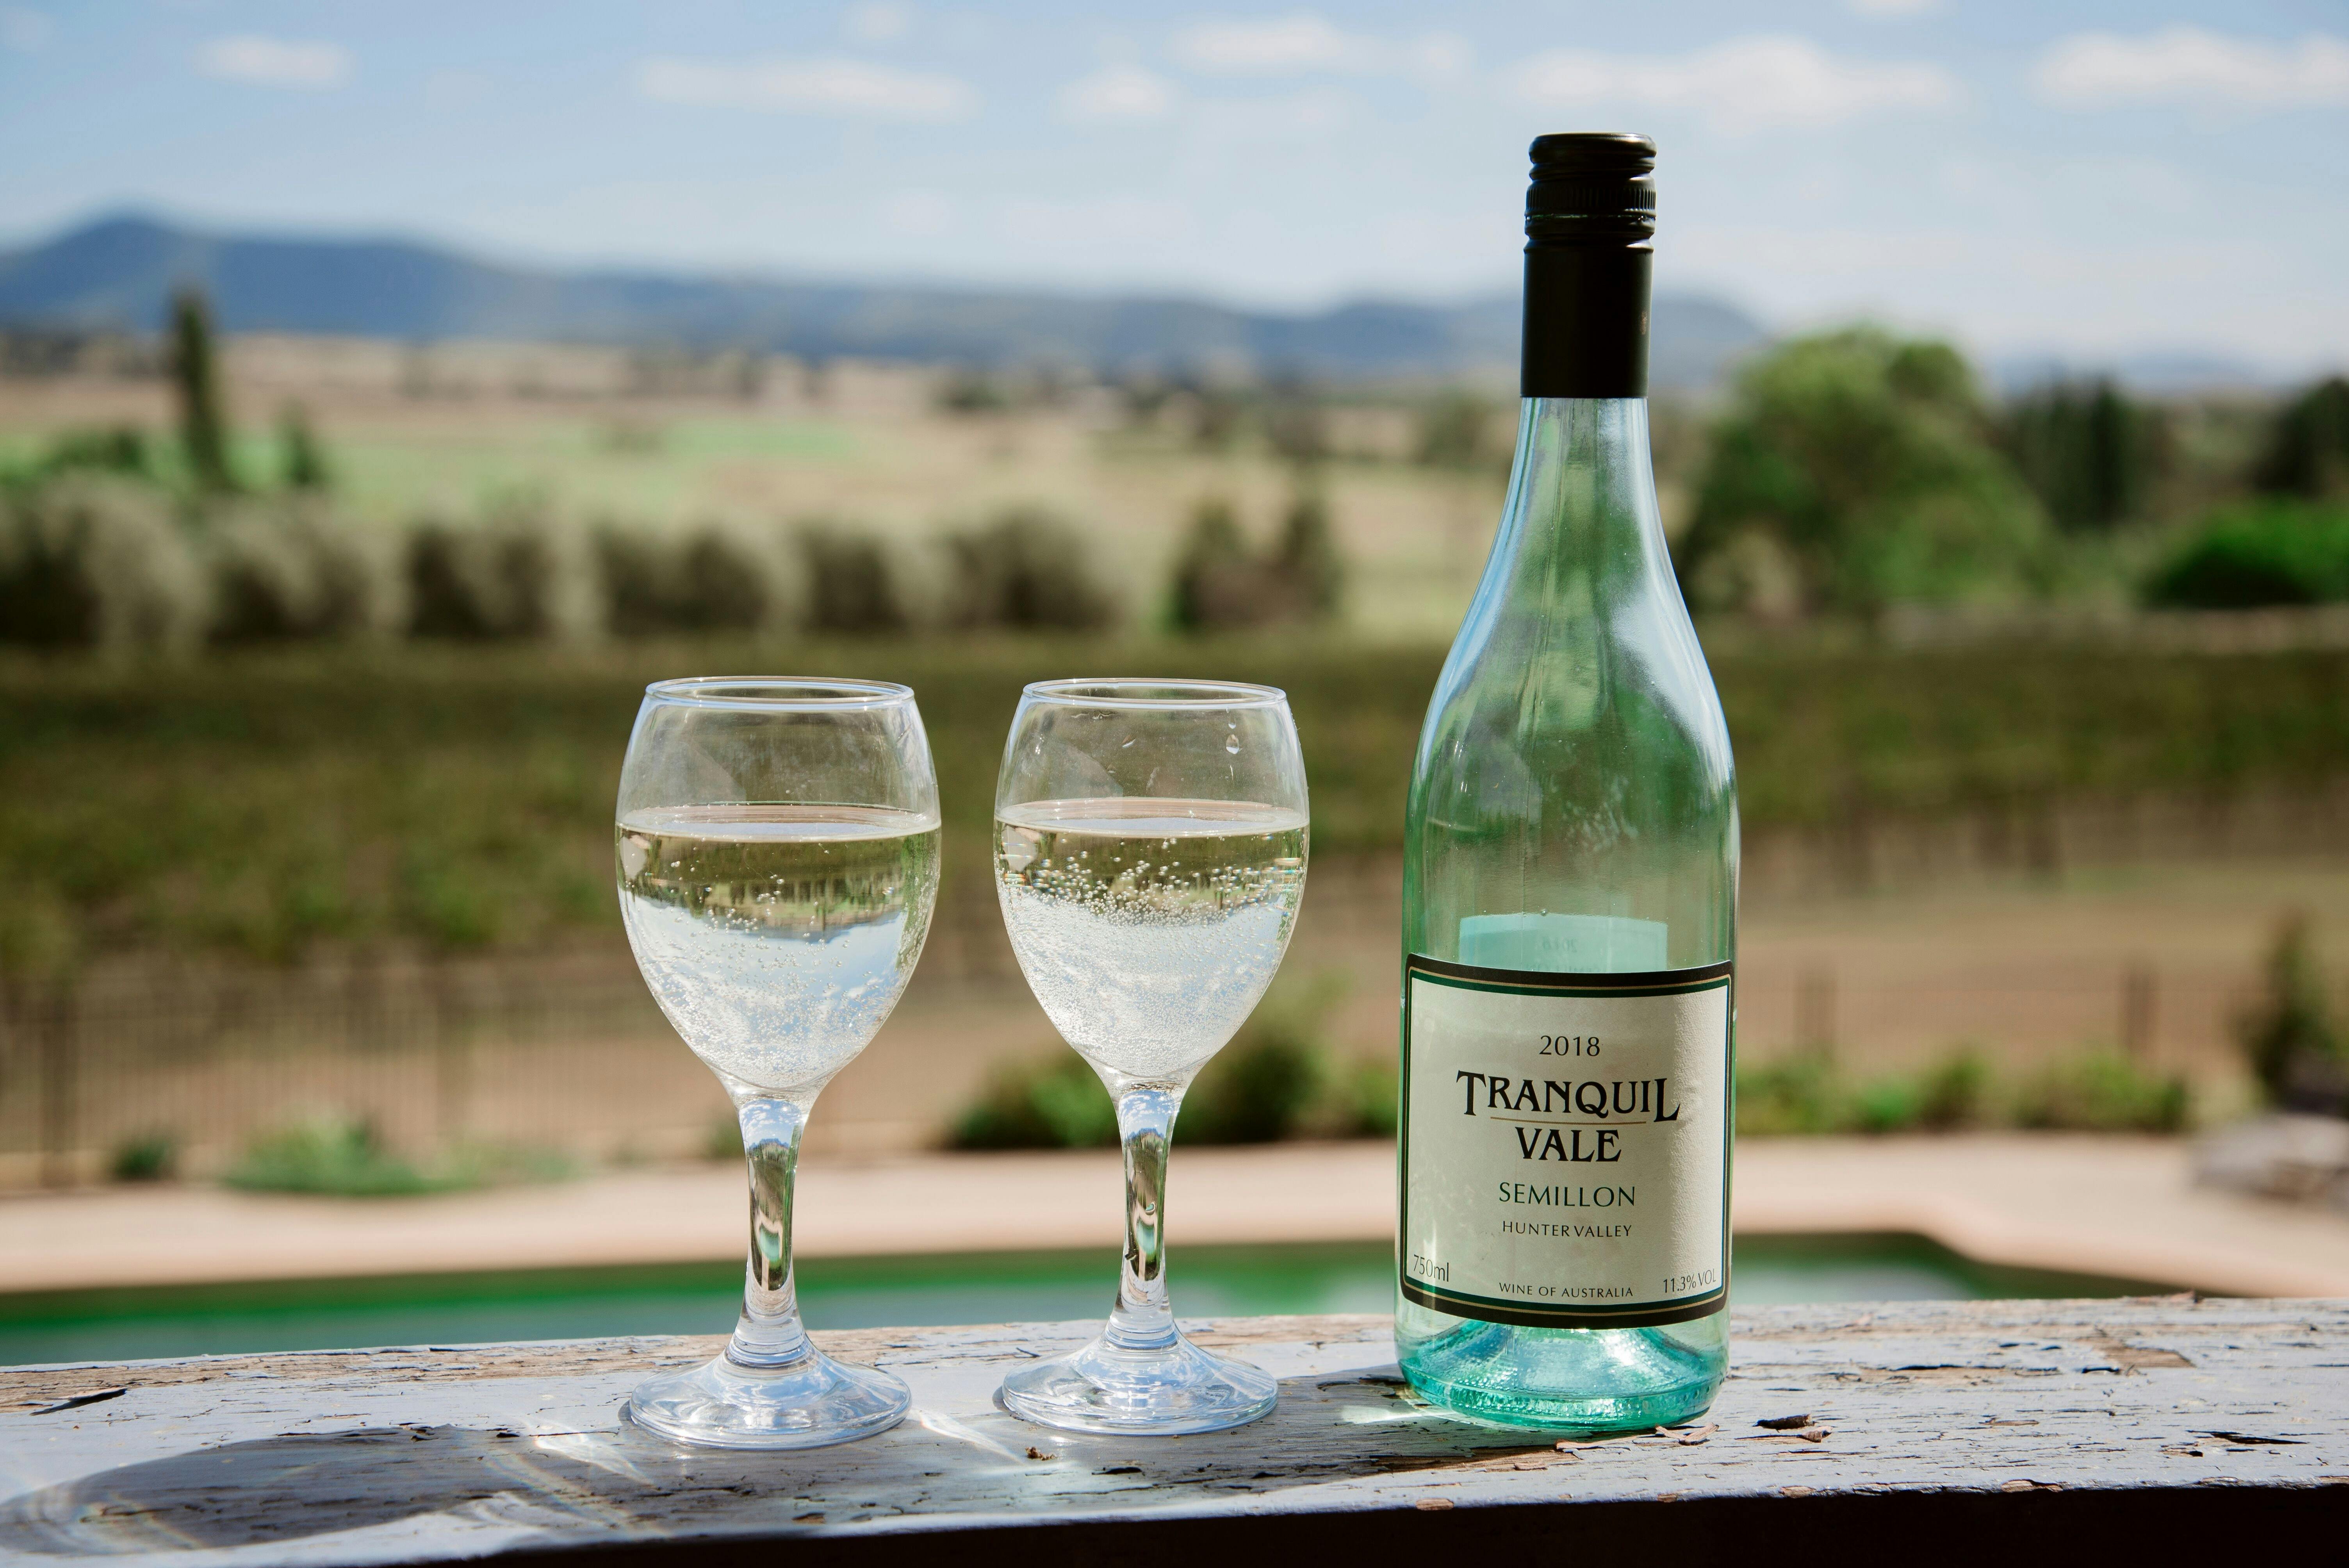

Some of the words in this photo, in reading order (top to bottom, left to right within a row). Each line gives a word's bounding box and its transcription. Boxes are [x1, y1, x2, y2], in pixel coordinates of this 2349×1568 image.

[1539, 1035, 1600, 1057] 2018
[1456, 1070, 1681, 1123] TRANQUIL
[1515, 1127, 1622, 1162] VALE
[1499, 1182, 1635, 1207] SEMILLON
[1503, 1221, 1570, 1237] HUNTER
[1574, 1225, 1632, 1237] VALLEY
[1413, 1254, 1449, 1282] 750ml
[1499, 1282, 1533, 1295] WINE
[1539, 1286, 1556, 1297] OF
[1562, 1287, 1633, 1298] AUSTRALIA
[1663, 1274, 1697, 1294] 11.3%
[1698, 1269, 1716, 1286] VOL
